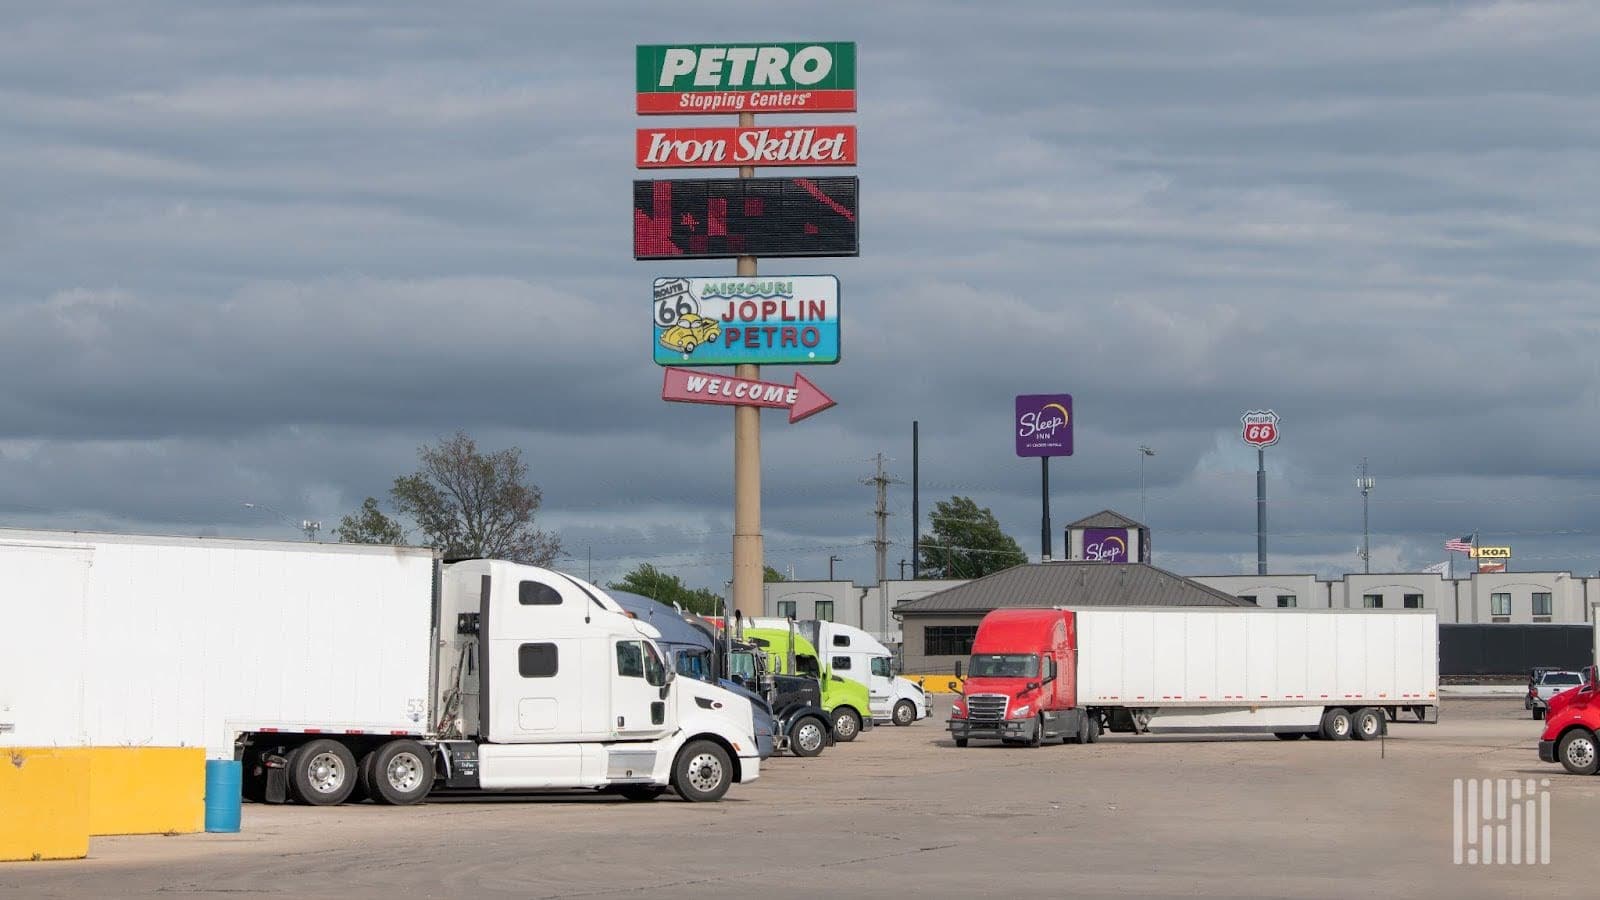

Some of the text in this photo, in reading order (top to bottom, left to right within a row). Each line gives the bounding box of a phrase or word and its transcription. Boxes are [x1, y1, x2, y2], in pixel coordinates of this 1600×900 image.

[659, 46, 833, 87] PETRO
[680, 93, 745, 109] Stopping
[644, 129, 847, 163] Iron Skillet
[655, 283, 683, 299] ROUTE
[702, 281, 793, 296] MISSOURI
[659, 295, 692, 324] 66
[722, 300, 826, 322] JOPLIN
[725, 326, 820, 348] PETRO
[687, 375, 800, 404] WELCOME
[1020, 411, 1064, 437] Sleep
[1250, 426, 1271, 439] 66
[1086, 542, 1121, 562] Sleep
[407, 699, 425, 713] 53
